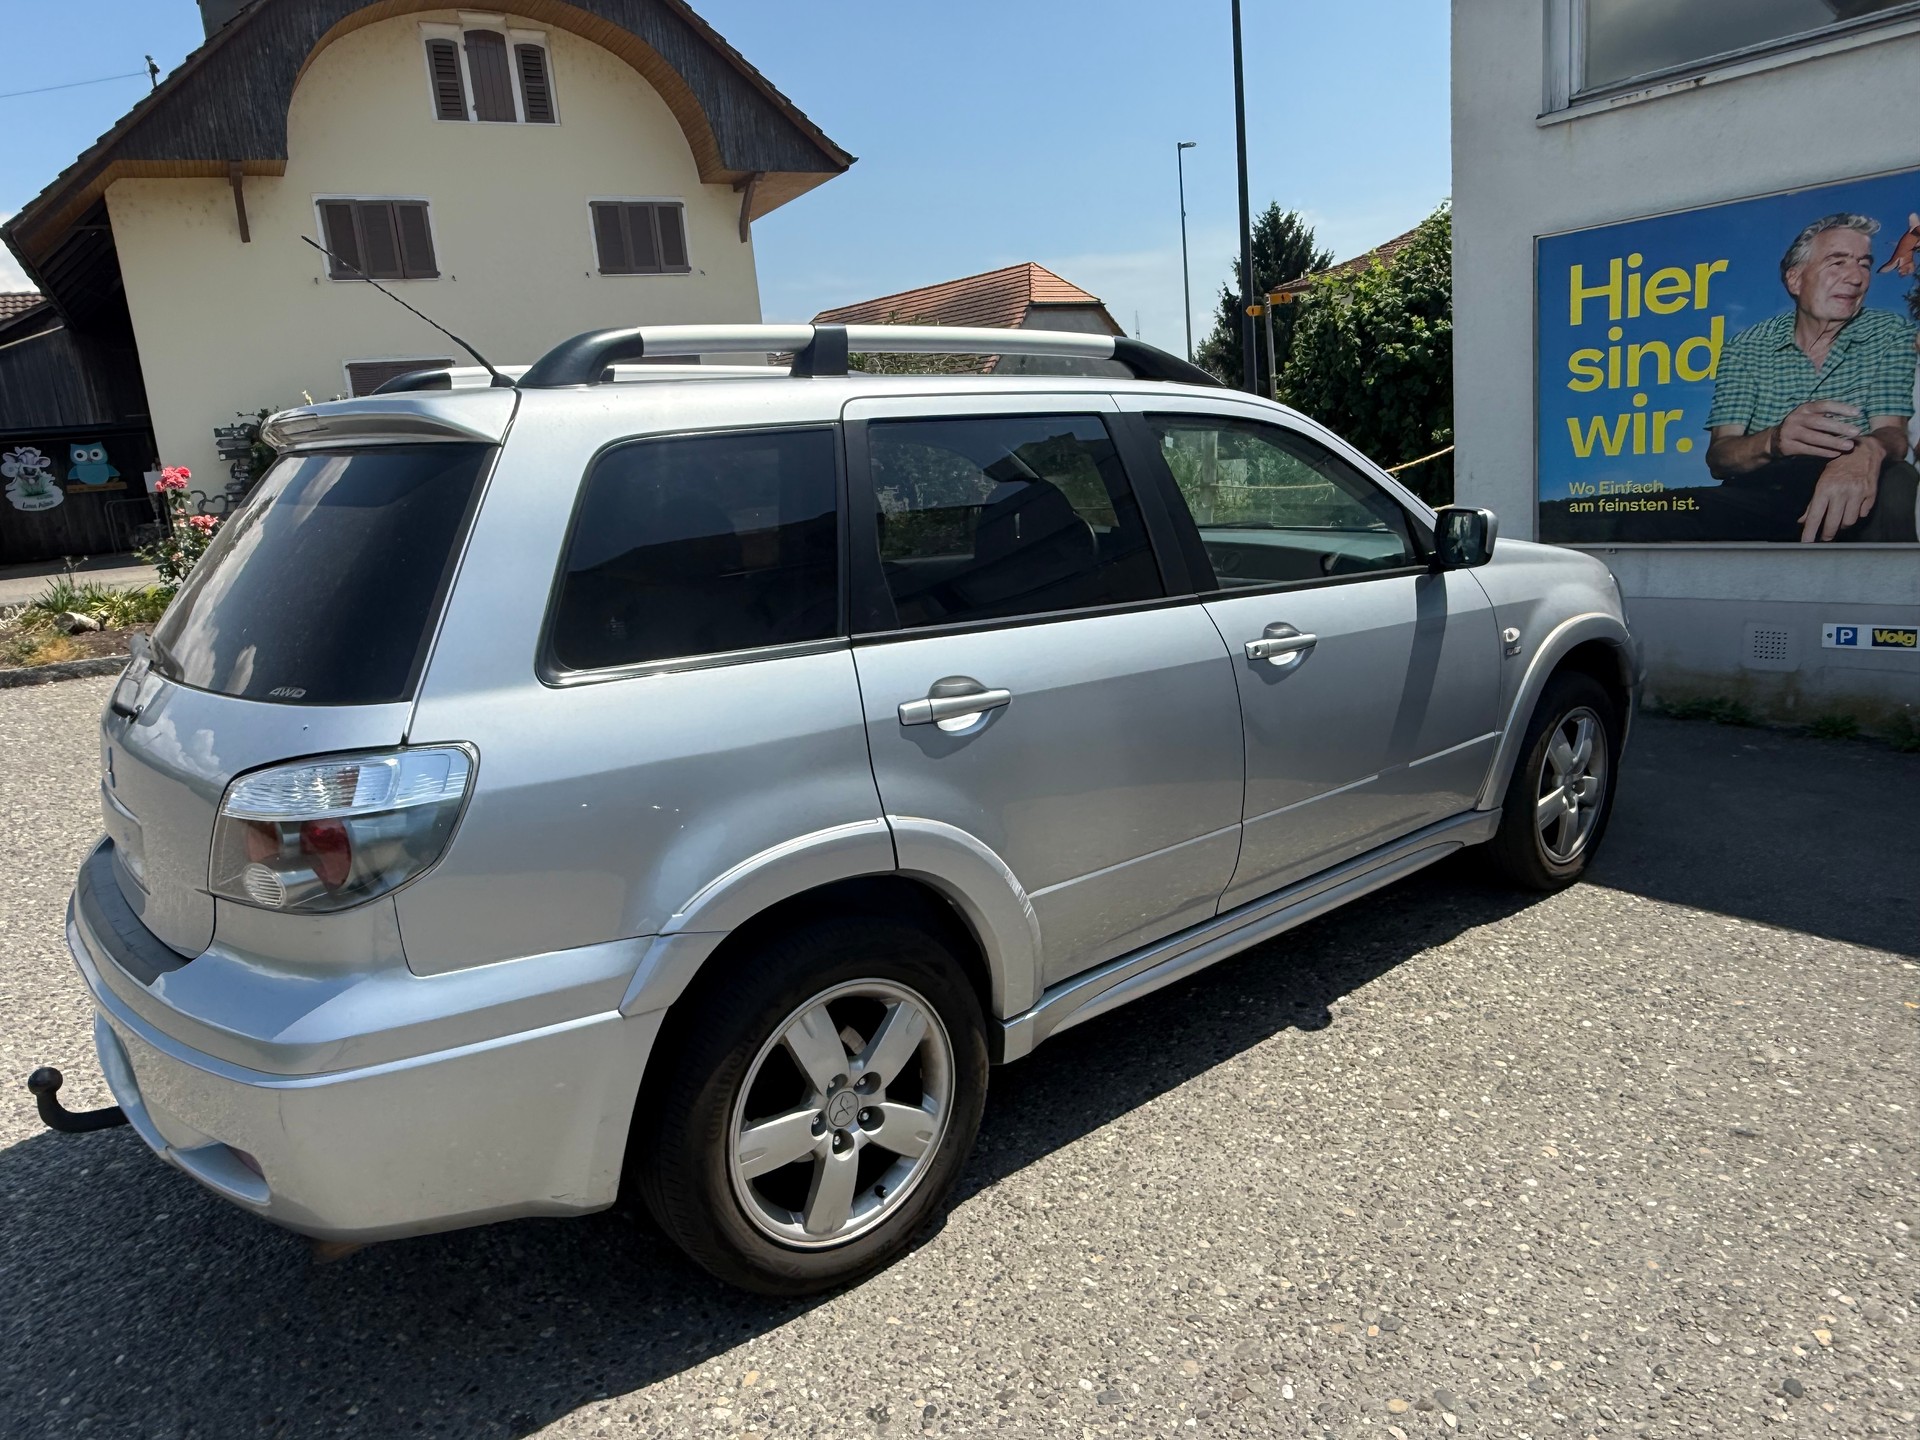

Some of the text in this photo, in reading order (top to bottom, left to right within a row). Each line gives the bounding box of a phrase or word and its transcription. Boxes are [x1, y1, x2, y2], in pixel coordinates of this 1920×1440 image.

[1569, 252, 1729, 326] Hier
[1566, 315, 1725, 393] sind
[1566, 393, 1693, 458] wir.
[1569, 480, 1664, 495] Wo Einfach
[1569, 496, 1700, 513] am feinsten ist.
[1840, 629, 1917, 647] P Volg
